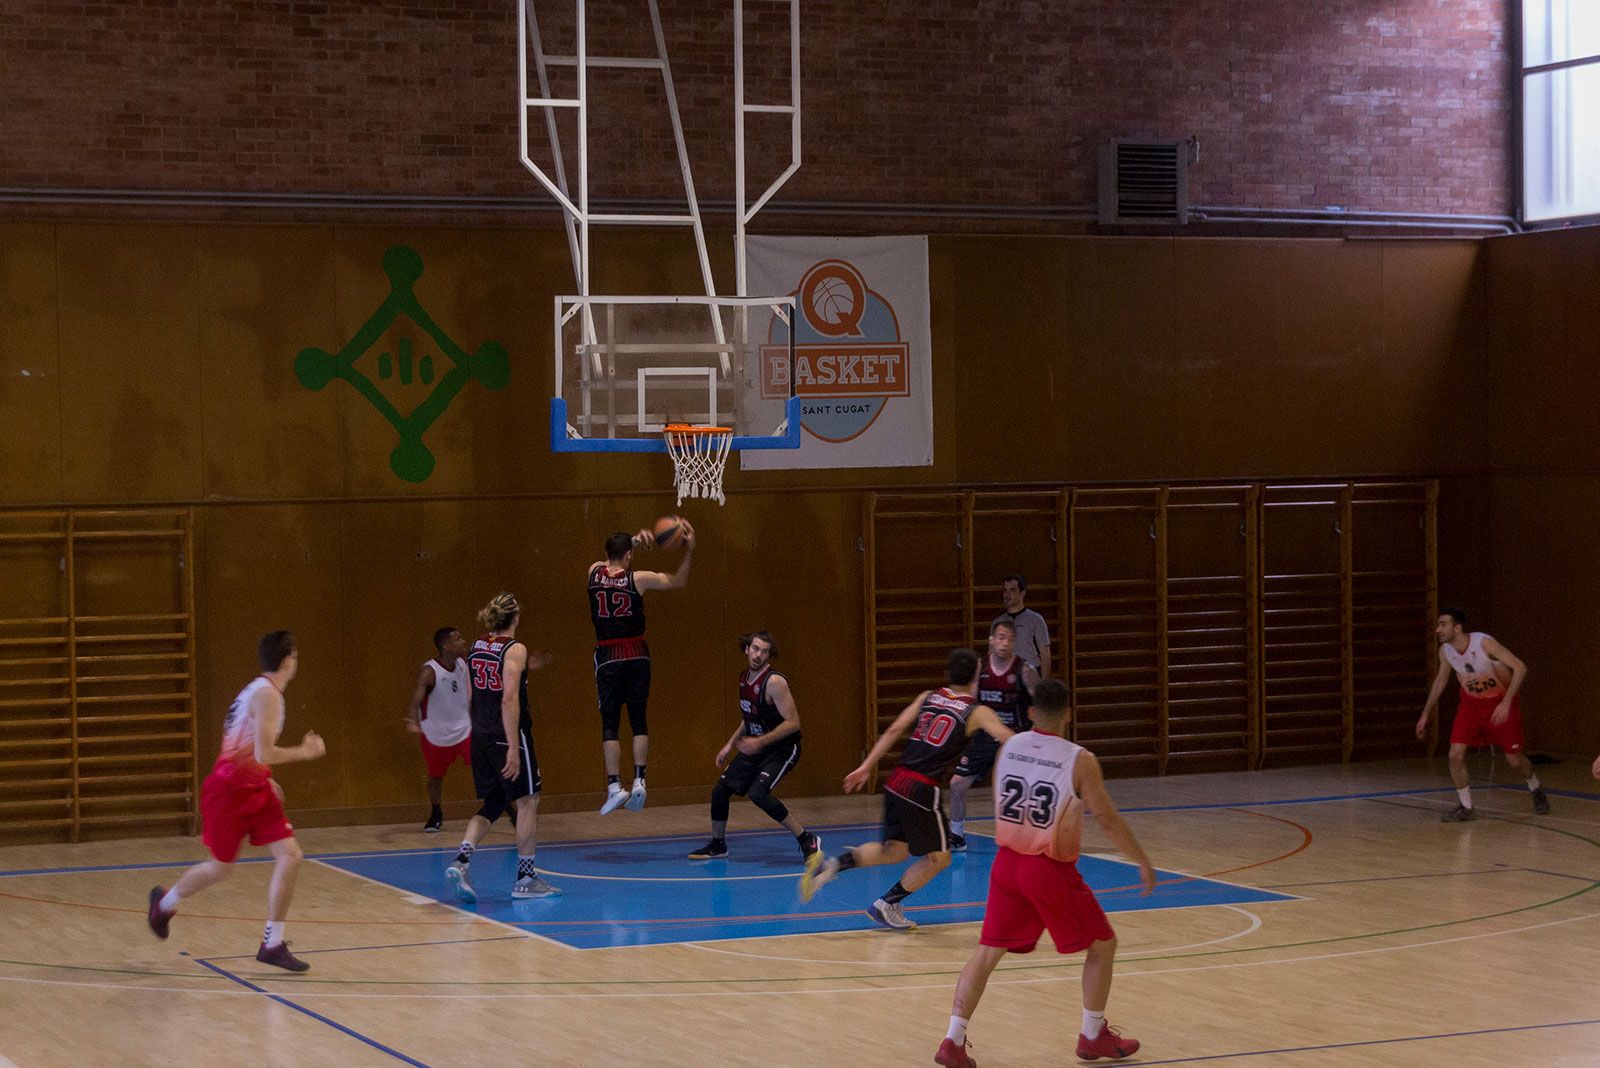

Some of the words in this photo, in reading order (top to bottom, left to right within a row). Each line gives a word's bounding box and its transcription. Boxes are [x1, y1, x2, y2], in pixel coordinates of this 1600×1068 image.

[803, 265, 864, 336] Q
[770, 355, 900, 385] BASKET
[802, 406, 830, 415] SANT
[835, 404, 871, 413] CUGAT
[595, 591, 633, 618] 12
[471, 658, 503, 691] 33
[999, 774, 1059, 829] 23
